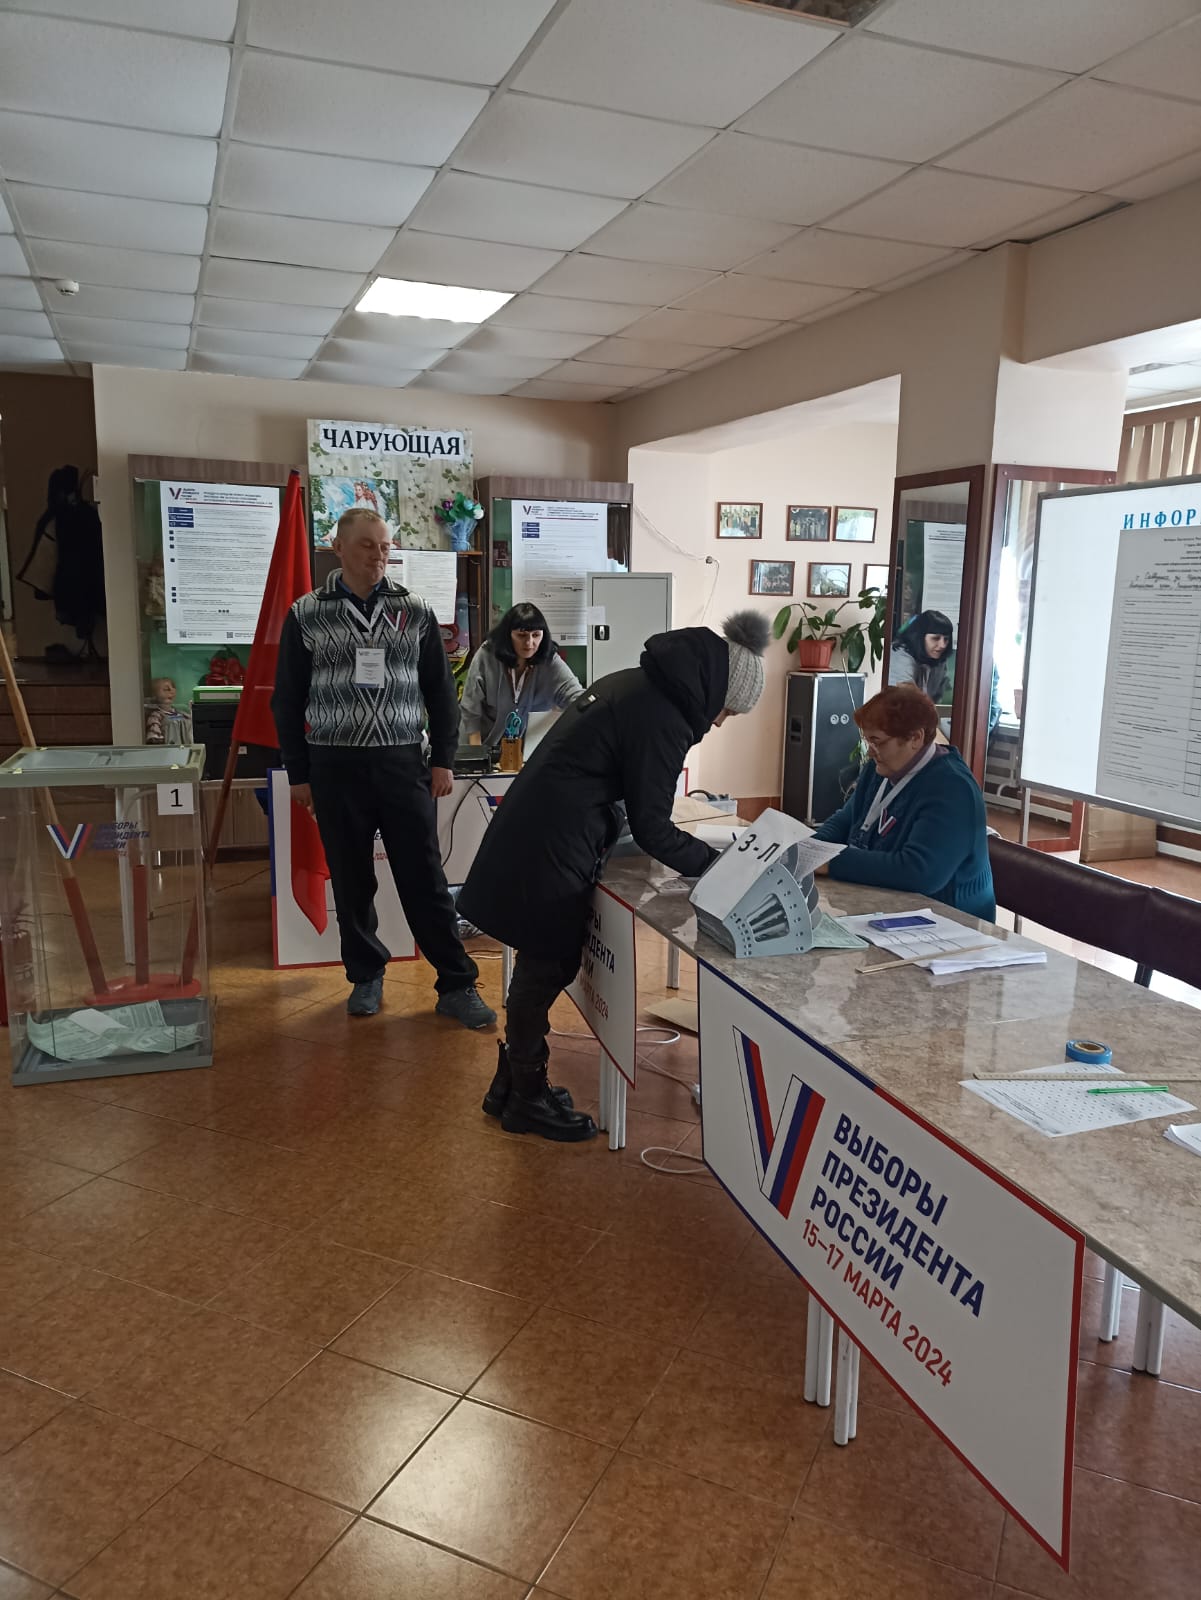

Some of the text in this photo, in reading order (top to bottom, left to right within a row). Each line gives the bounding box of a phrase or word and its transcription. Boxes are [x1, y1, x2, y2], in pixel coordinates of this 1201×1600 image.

[322, 427, 461, 459] ЧАРУЮЩАЯ
[1123, 508, 1200, 530] ИНФОР
[169, 787, 184, 808] 1
[832, 1112, 949, 1227] ВЫБОРЫ
[809, 1184, 905, 1291] РОССИИ
[820, 1149, 986, 1318] ПРЕЗИДЕНТА
[842, 1261, 903, 1337] МАРТА
[902, 1323, 954, 1388] 2024
